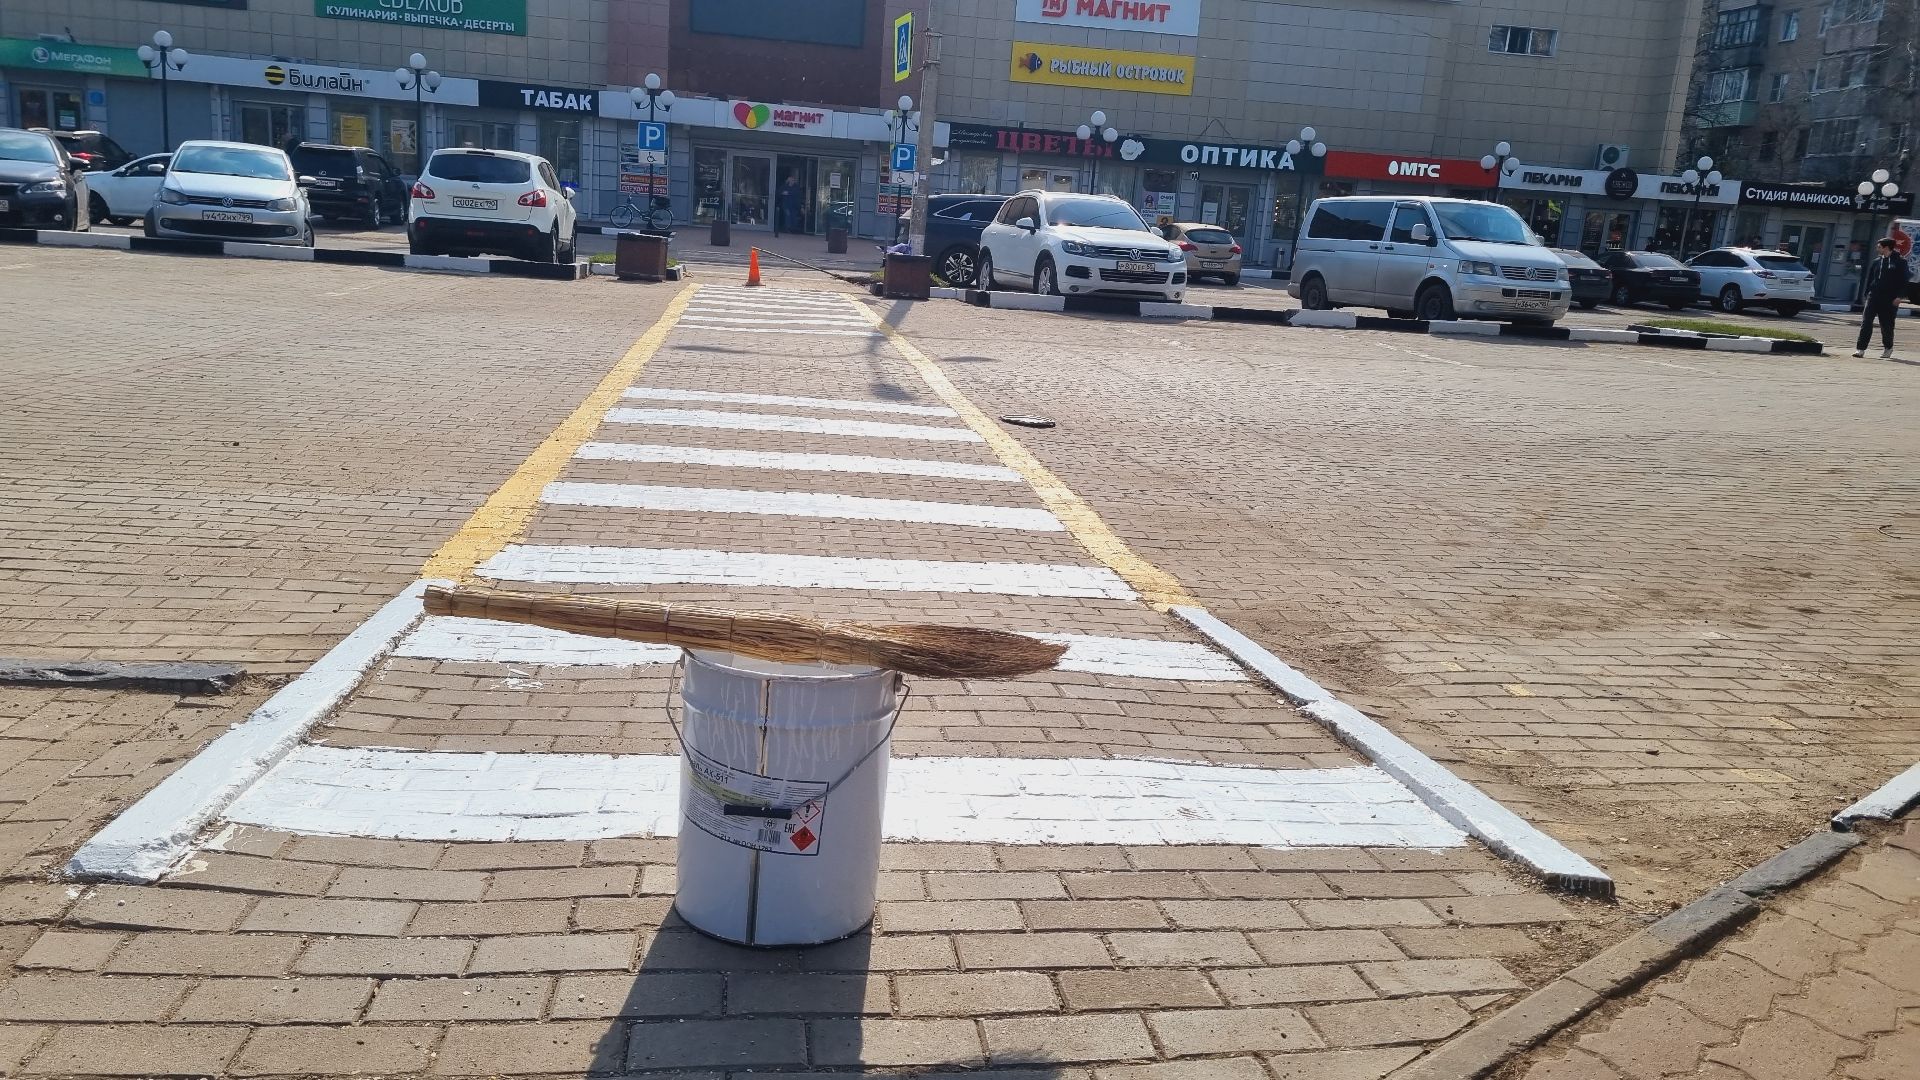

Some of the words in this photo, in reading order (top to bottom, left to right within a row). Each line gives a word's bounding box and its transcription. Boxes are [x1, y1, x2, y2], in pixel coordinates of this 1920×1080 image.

[326, 5, 397, 21] КУЛИНАРИЯ
[404, 13, 459, 27] ВЫПЕЧКА
[463, 18, 515, 32] ДЕСЕРТЫ
[1076, 0, 1170, 23] МАГНИТ
[288, 68, 363, 92] Билайн
[1050, 58, 1112, 78] РЫБНЫЙ
[1116, 64, 1185, 84] ОСТРОВОК
[520, 89, 592, 111] ТАБАК
[996, 130, 1113, 158] ЦВЕТЫ
[1180, 144, 1295, 171] ОПТИКА
[1400, 161, 1440, 178] МТС
[1522, 171, 1583, 187] ПЕКАРНЯ
[1789, 192, 1851, 206] МАНИКЮРА
